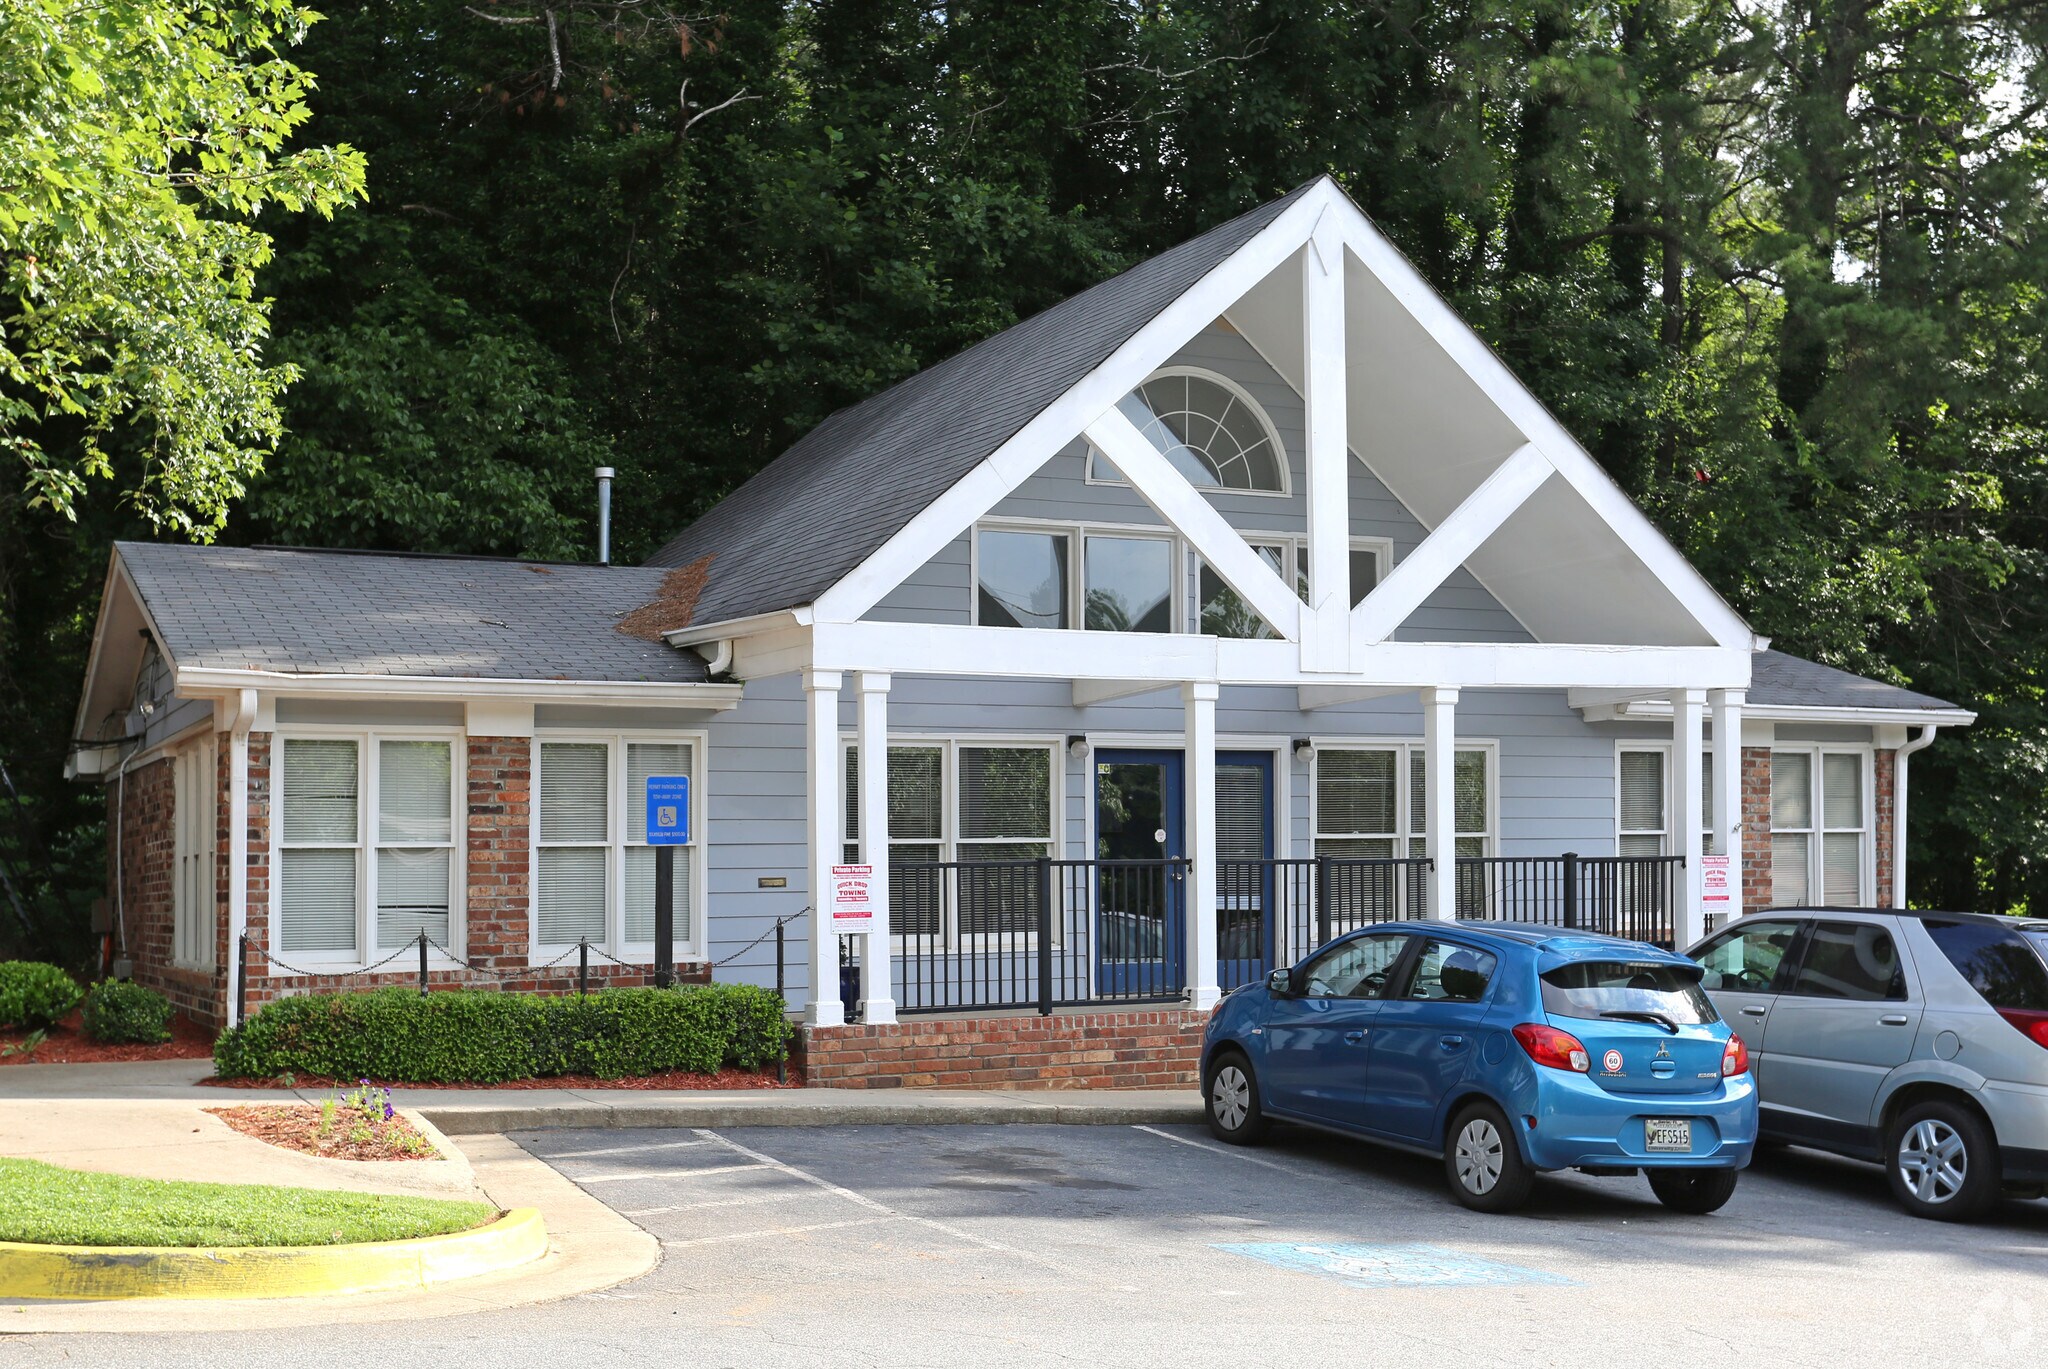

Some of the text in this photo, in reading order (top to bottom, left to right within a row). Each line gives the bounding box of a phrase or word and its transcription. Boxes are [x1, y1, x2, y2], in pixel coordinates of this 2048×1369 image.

[851, 866, 870, 874] Parking
[837, 881, 868, 890] QUICK DROP
[1609, 1057, 1618, 1065] 60
[1657, 1129, 1689, 1144] EFS515
